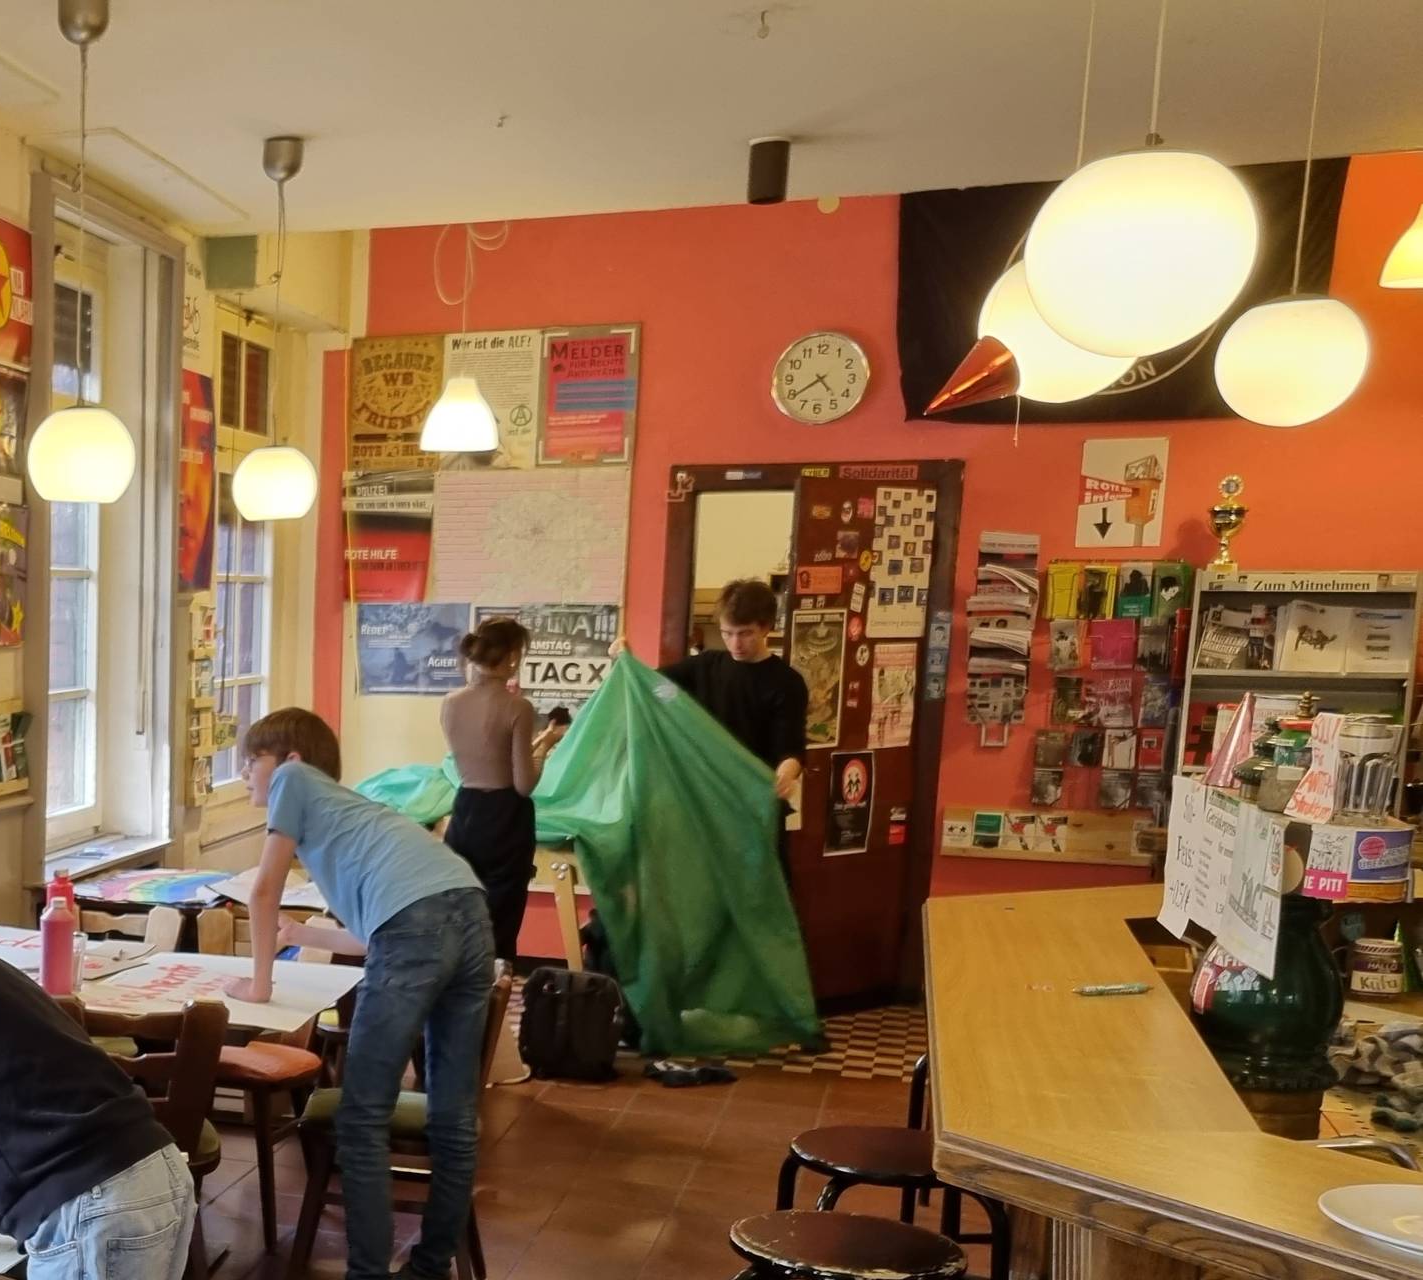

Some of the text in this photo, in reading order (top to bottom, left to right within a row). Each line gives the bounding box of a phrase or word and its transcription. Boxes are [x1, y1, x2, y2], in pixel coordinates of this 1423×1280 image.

[474, 336, 487, 350] ist
[490, 336, 505, 350] die
[817, 343, 830, 355] 12
[802, 347, 813, 359] 11
[837, 347, 842, 358] 1
[789, 359, 802, 370] 10
[844, 358, 854, 370] 2
[784, 374, 794, 385] 9
[847, 373, 856, 384] 3
[787, 388, 797, 400] 8
[841, 388, 850, 398] 4
[800, 399, 808, 411] 7
[812, 403, 822, 415] 6
[829, 399, 838, 410] 5
[344, 549, 399, 560] ROTE HILFE
[1253, 579, 1371, 591] Zum Mitnehmen
[530, 640, 571, 651] AMSTAG
[525, 661, 607, 685] TAG X
[1318, 876, 1343, 893] PIT!
